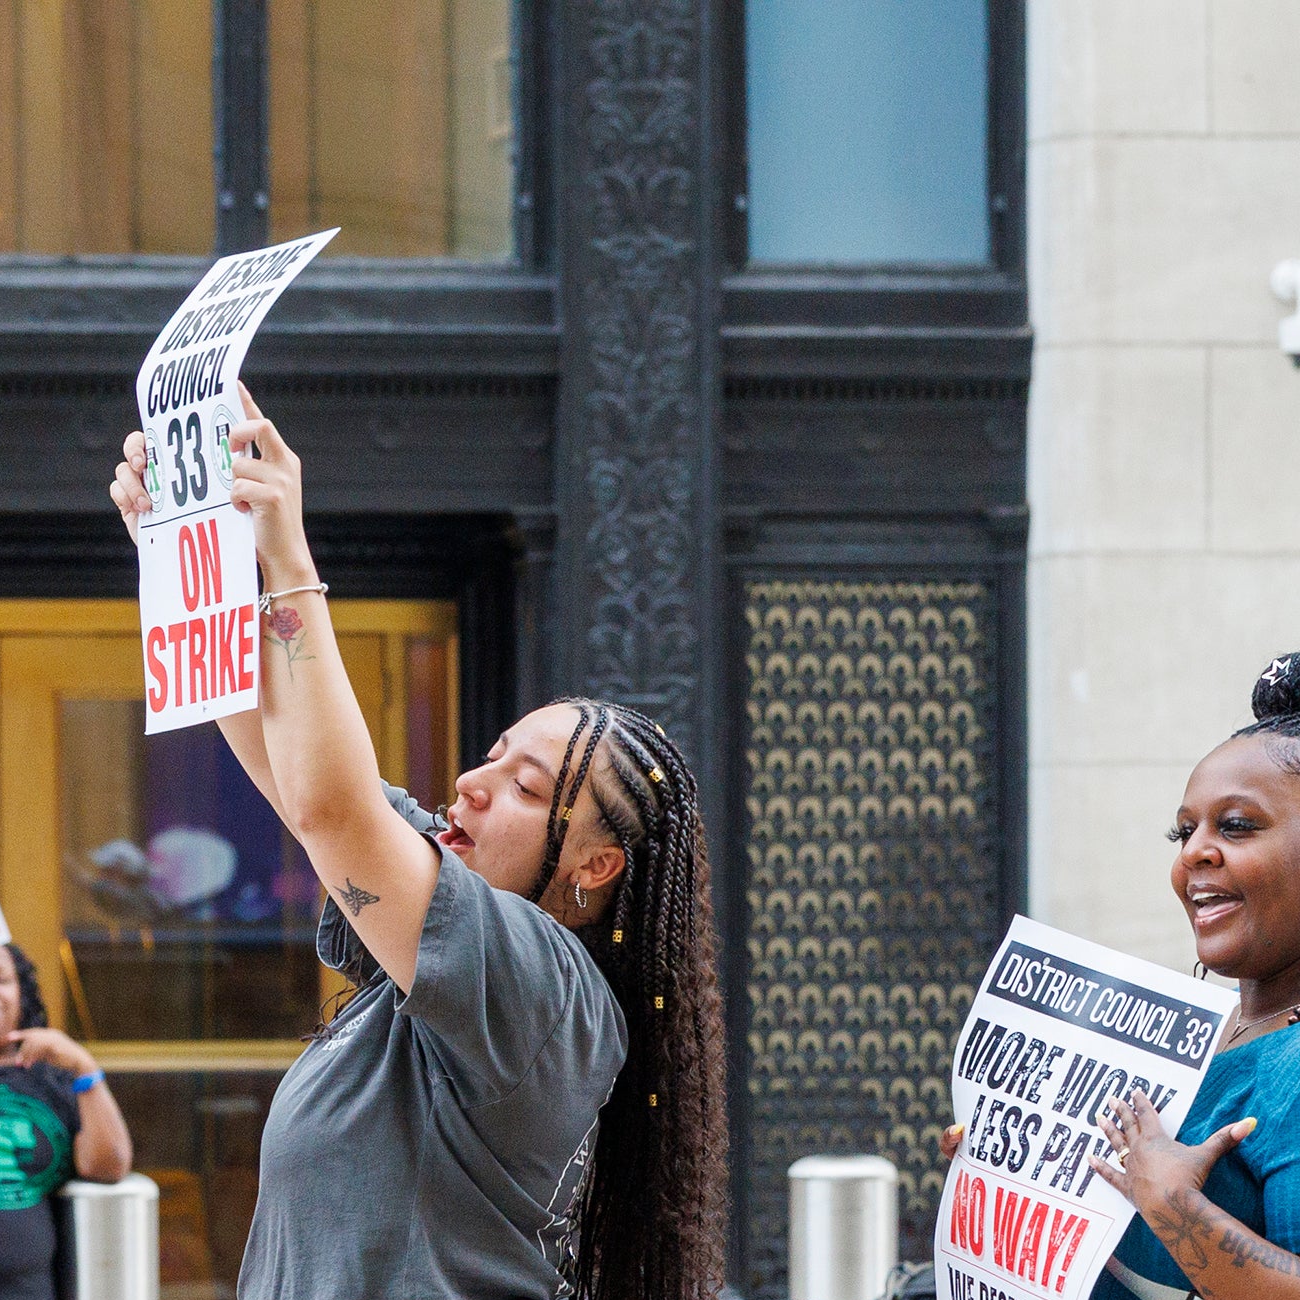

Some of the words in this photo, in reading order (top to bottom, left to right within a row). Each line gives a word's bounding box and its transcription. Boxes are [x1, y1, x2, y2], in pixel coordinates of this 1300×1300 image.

[200, 241, 315, 301] AFSCME
[160, 287, 275, 355] DISTRICT
[147, 344, 231, 418] COUNCIL
[167, 411, 208, 508] 33
[178, 518, 223, 613] ON
[147, 603, 254, 714] STRIKE
[996, 953, 1100, 1017] DISTRICT
[1089, 987, 1179, 1050] COUNCIL
[1176, 1017, 1213, 1060] 33
[957, 1017, 1067, 1105] MORE
[968, 1094, 1043, 1174] LESS
[950, 1169, 987, 1258] NO
[993, 1186, 1090, 1294] WAY!
